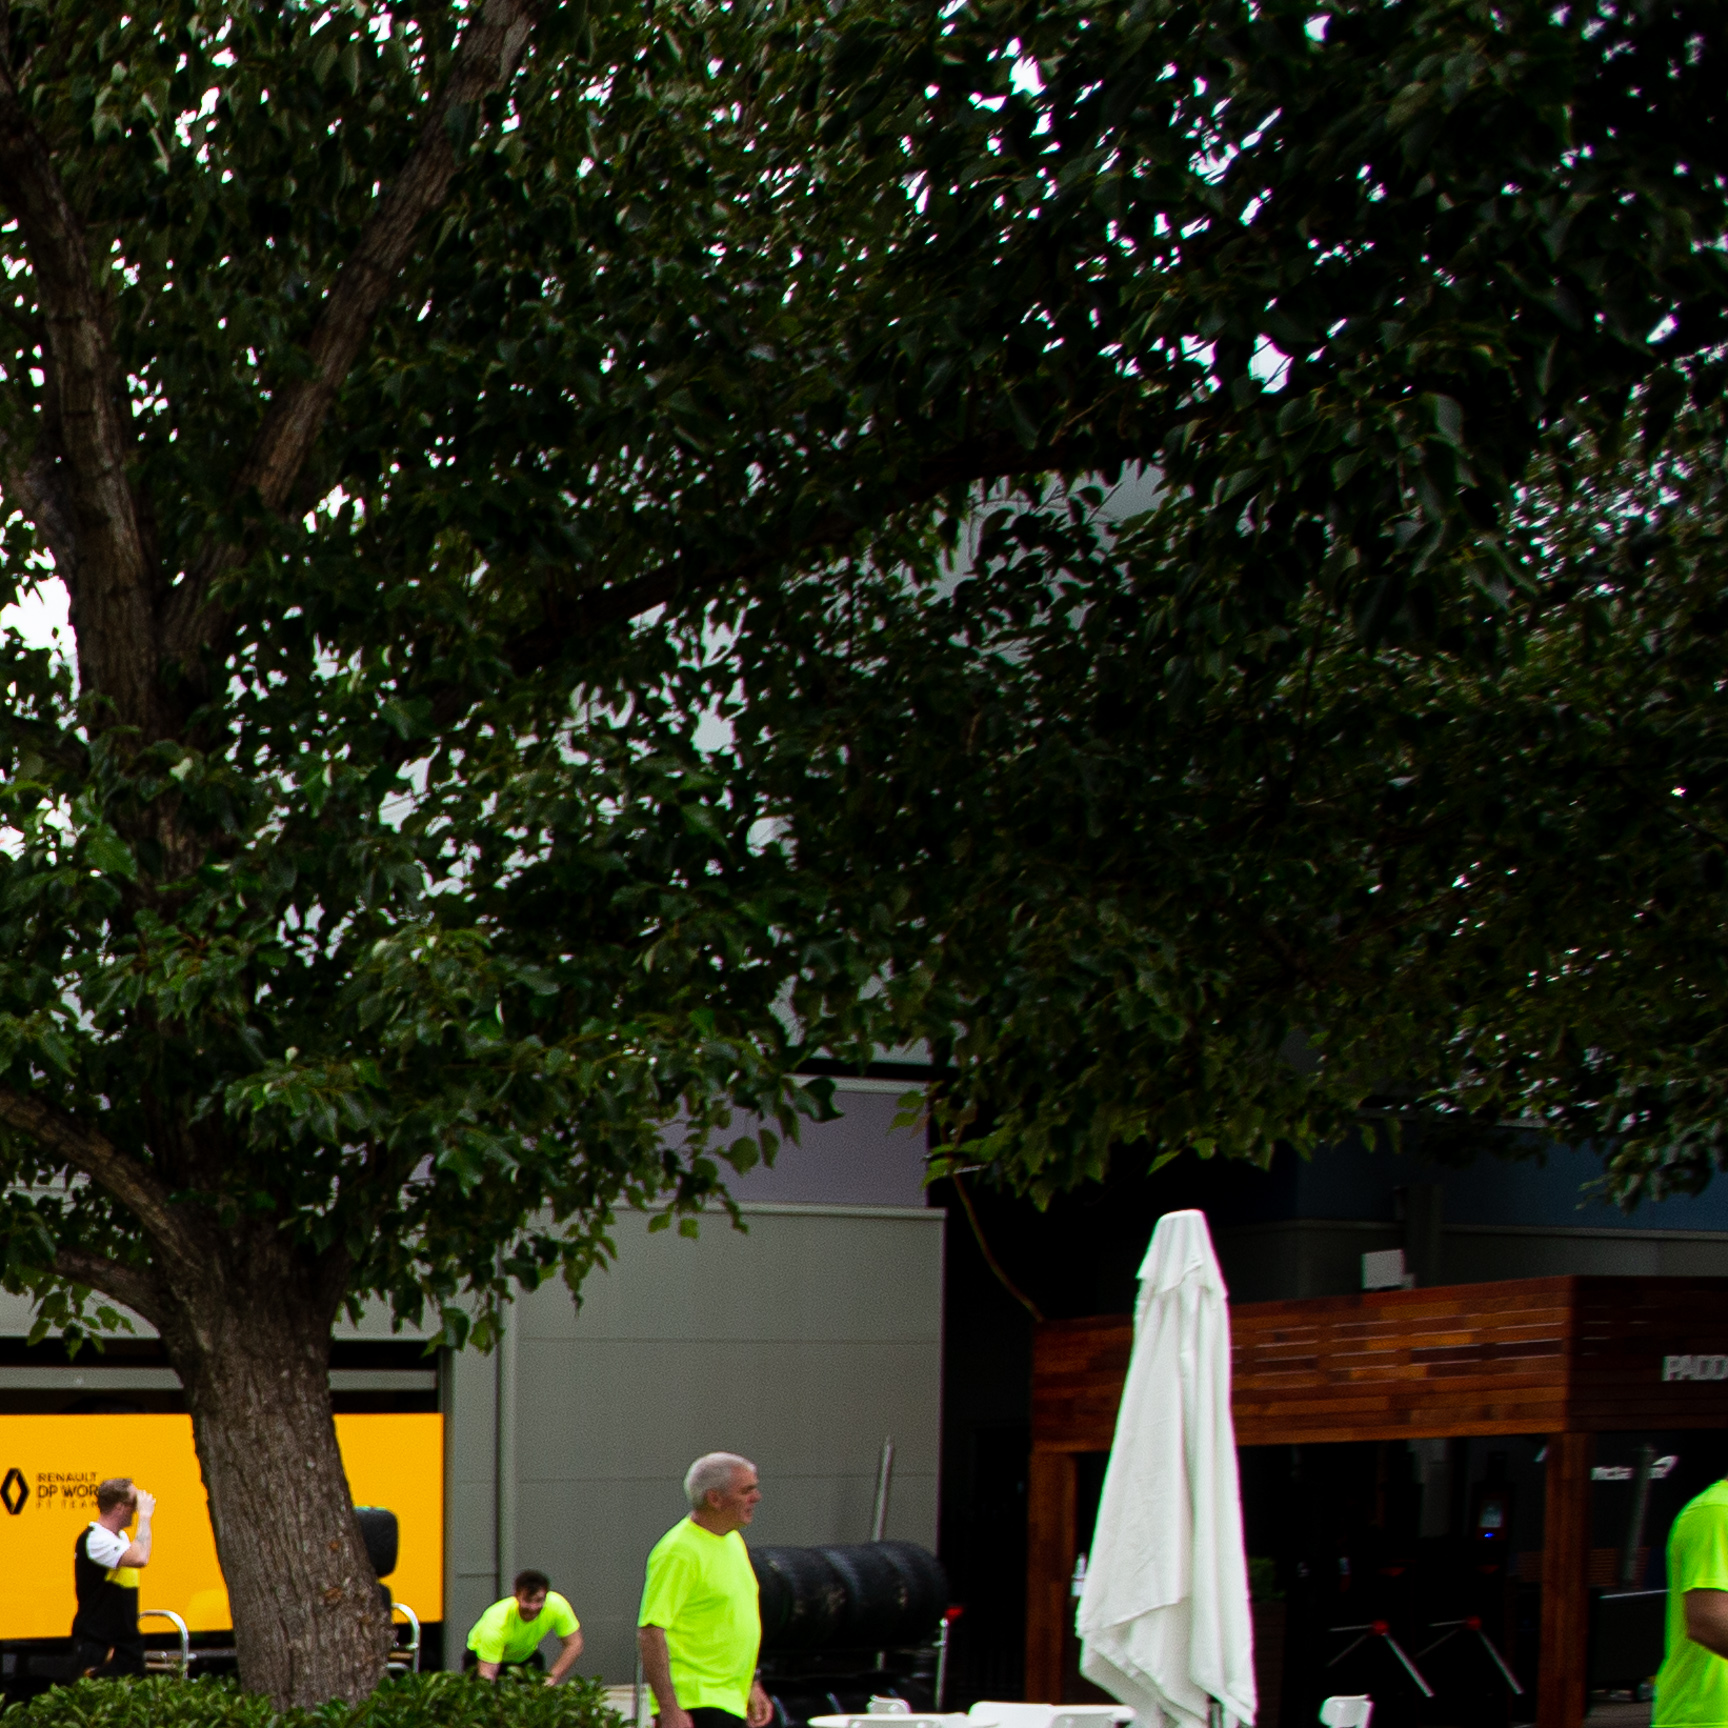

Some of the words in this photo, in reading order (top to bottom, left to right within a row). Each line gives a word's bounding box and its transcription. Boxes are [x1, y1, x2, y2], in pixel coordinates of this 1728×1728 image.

[1662, 1354, 1728, 1381] PADD
[37, 1472, 97, 1482] RENAULT
[38, 1485, 58, 1498] DP
[61, 1484, 99, 1498] WOR
